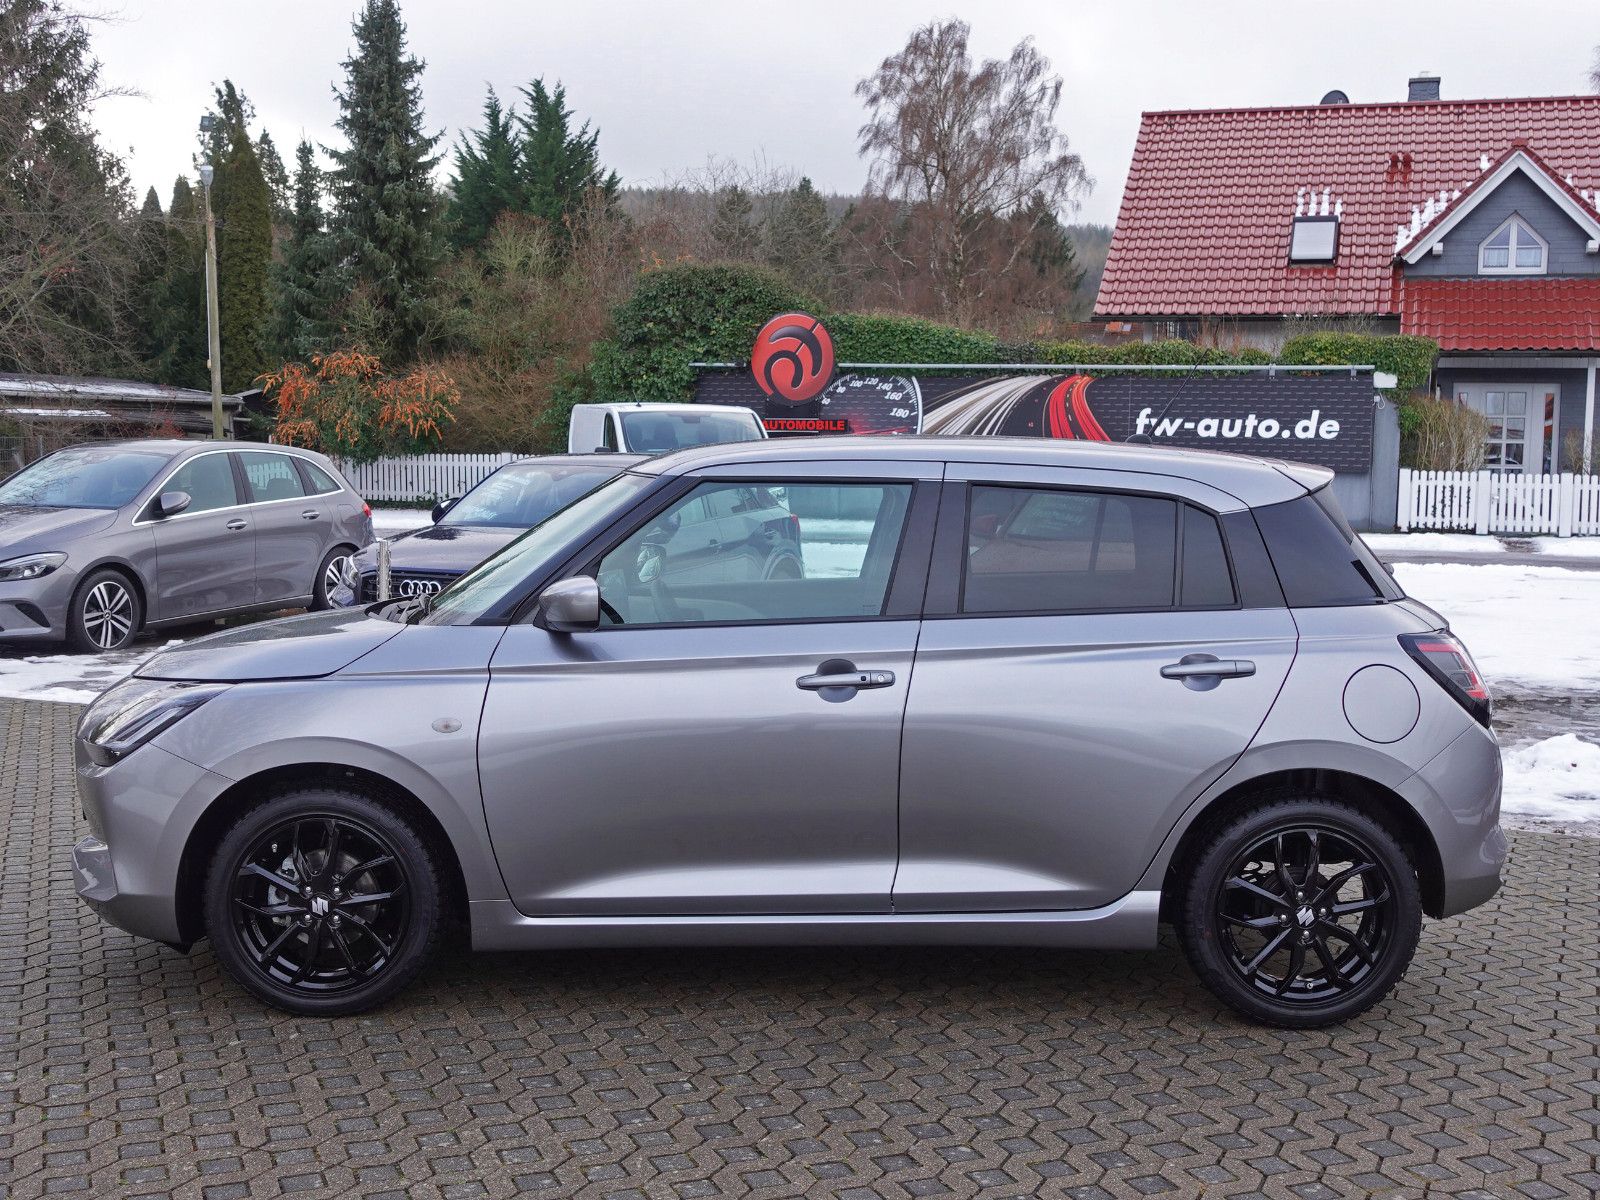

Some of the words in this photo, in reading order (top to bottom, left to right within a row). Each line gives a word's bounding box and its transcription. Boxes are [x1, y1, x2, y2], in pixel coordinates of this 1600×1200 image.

[876, 383, 893, 391] 140
[885, 392, 903, 400] 160
[890, 408, 909, 418] 180
[763, 420, 844, 430] AUTOMOBILE
[1136, 408, 1340, 439] fw-auto.de
